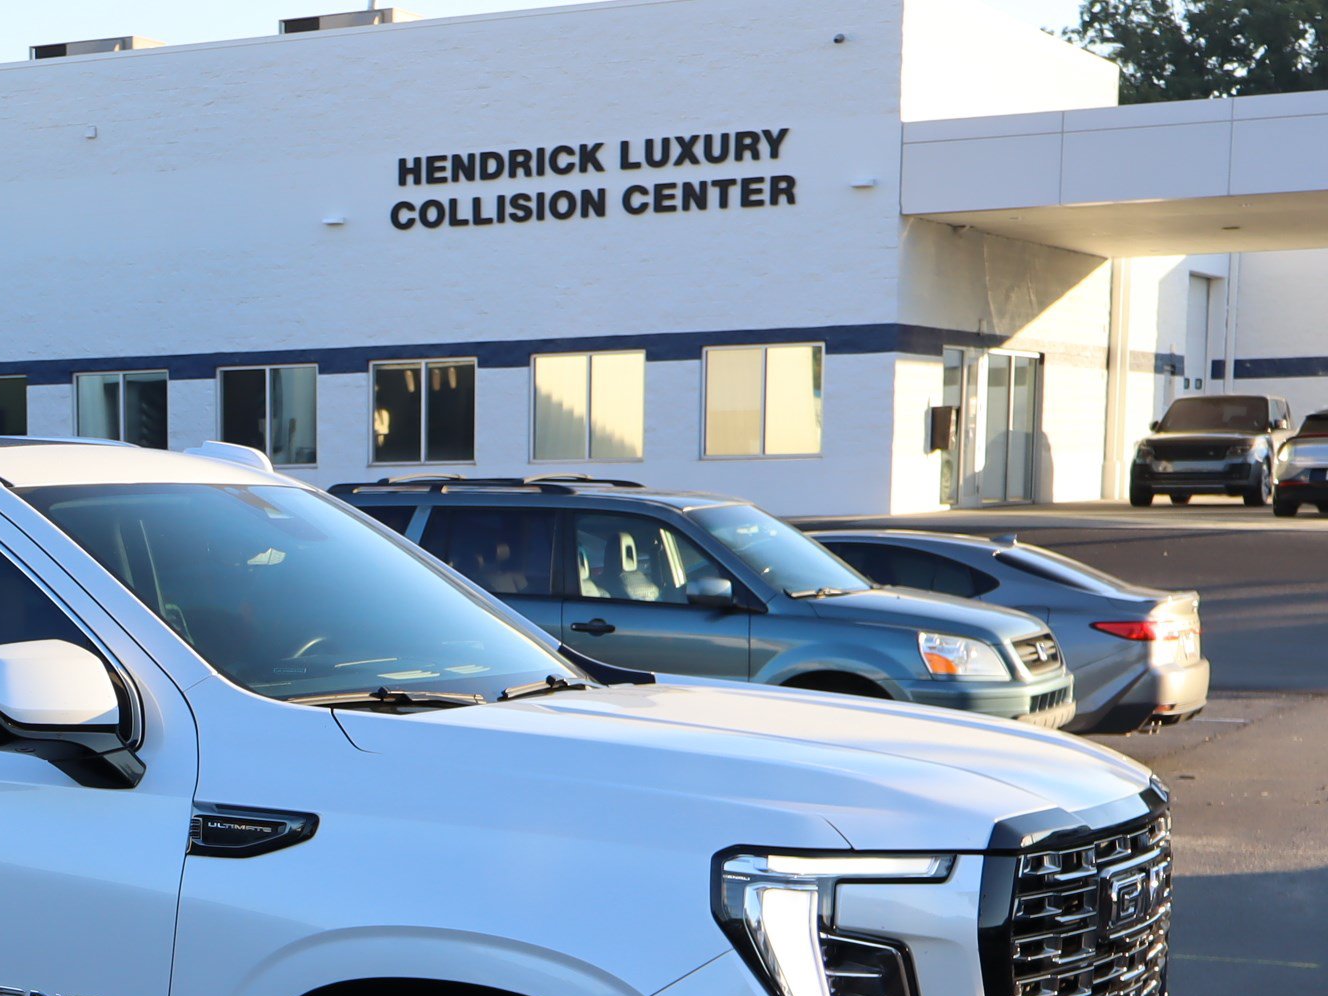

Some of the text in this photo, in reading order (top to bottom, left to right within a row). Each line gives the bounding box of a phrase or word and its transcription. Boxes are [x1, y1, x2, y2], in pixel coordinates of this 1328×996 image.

[398, 128, 790, 187] HENDRICK LUXURY
[390, 174, 796, 231] COLLISION CENTER
[207, 821, 272, 833] ULTIMATE
